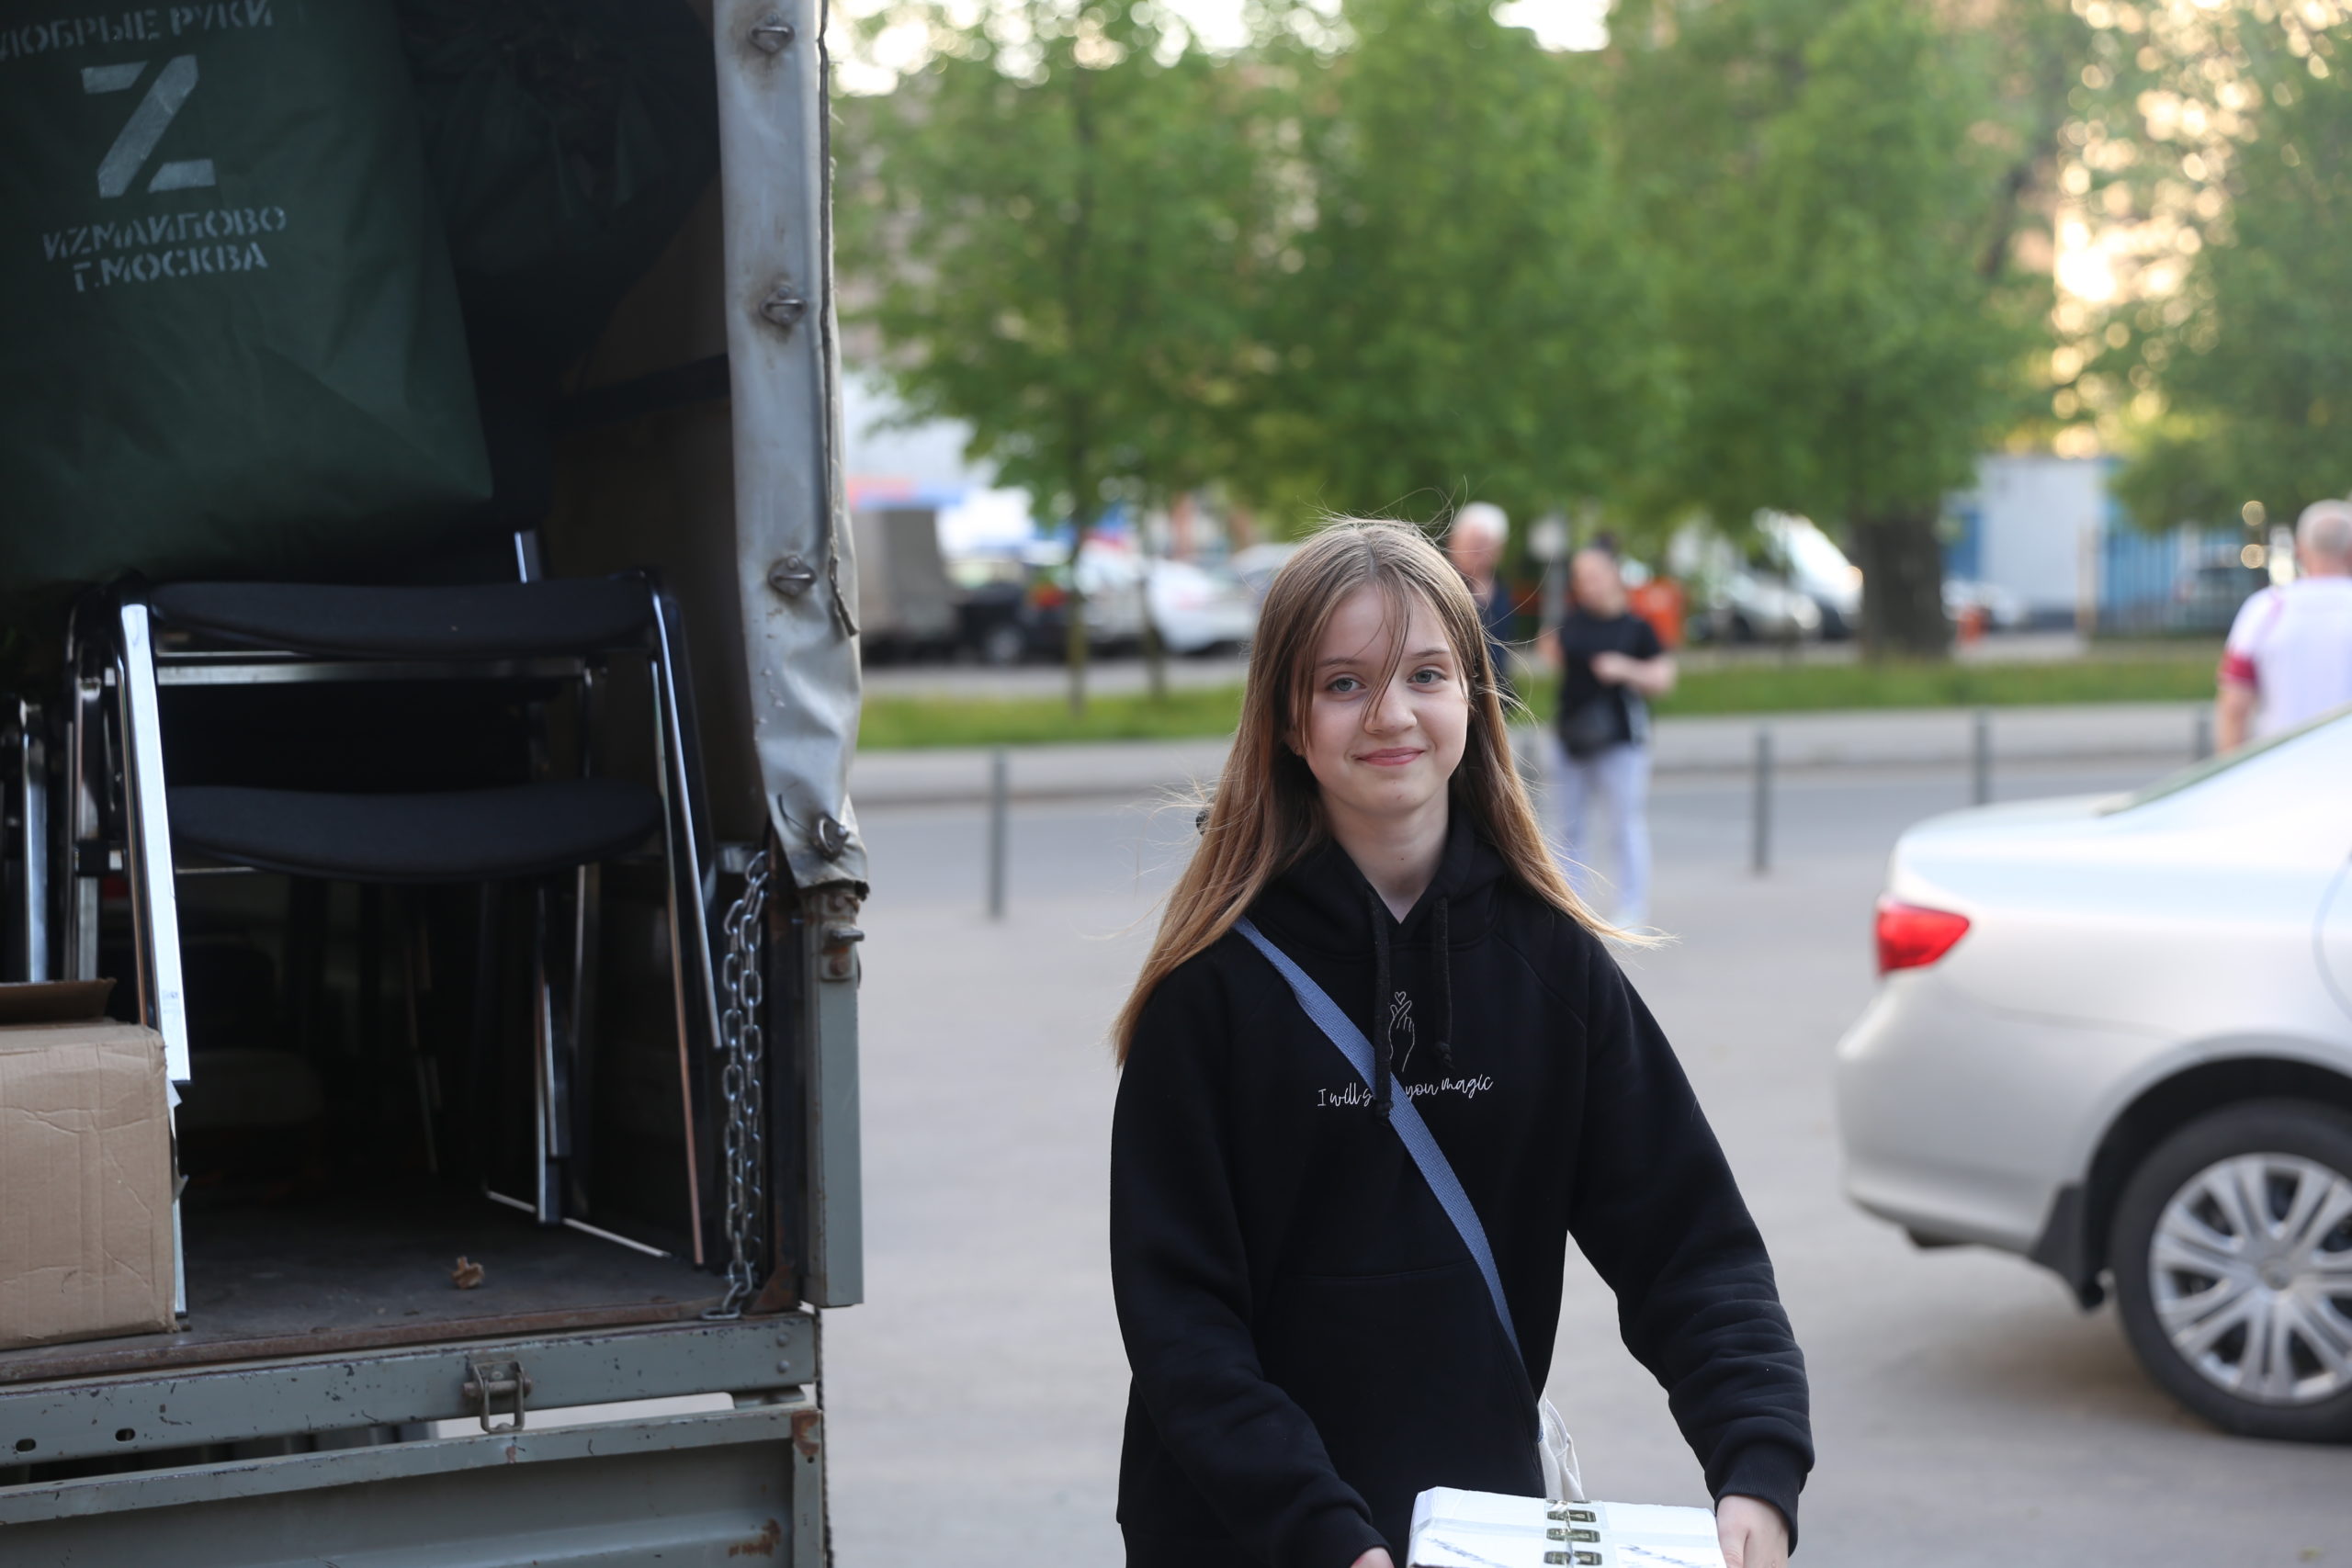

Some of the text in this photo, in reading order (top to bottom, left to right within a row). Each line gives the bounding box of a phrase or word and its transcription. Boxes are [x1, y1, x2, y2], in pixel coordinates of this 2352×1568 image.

[169, 0, 273, 36] РУКИ
[81, 53, 216, 198] Z
[1317, 1089, 1327, 1107] I
[1329, 1082, 1362, 1107] will
[1405, 1083, 1439, 1101] you
[1441, 1074, 1494, 1099] magic
